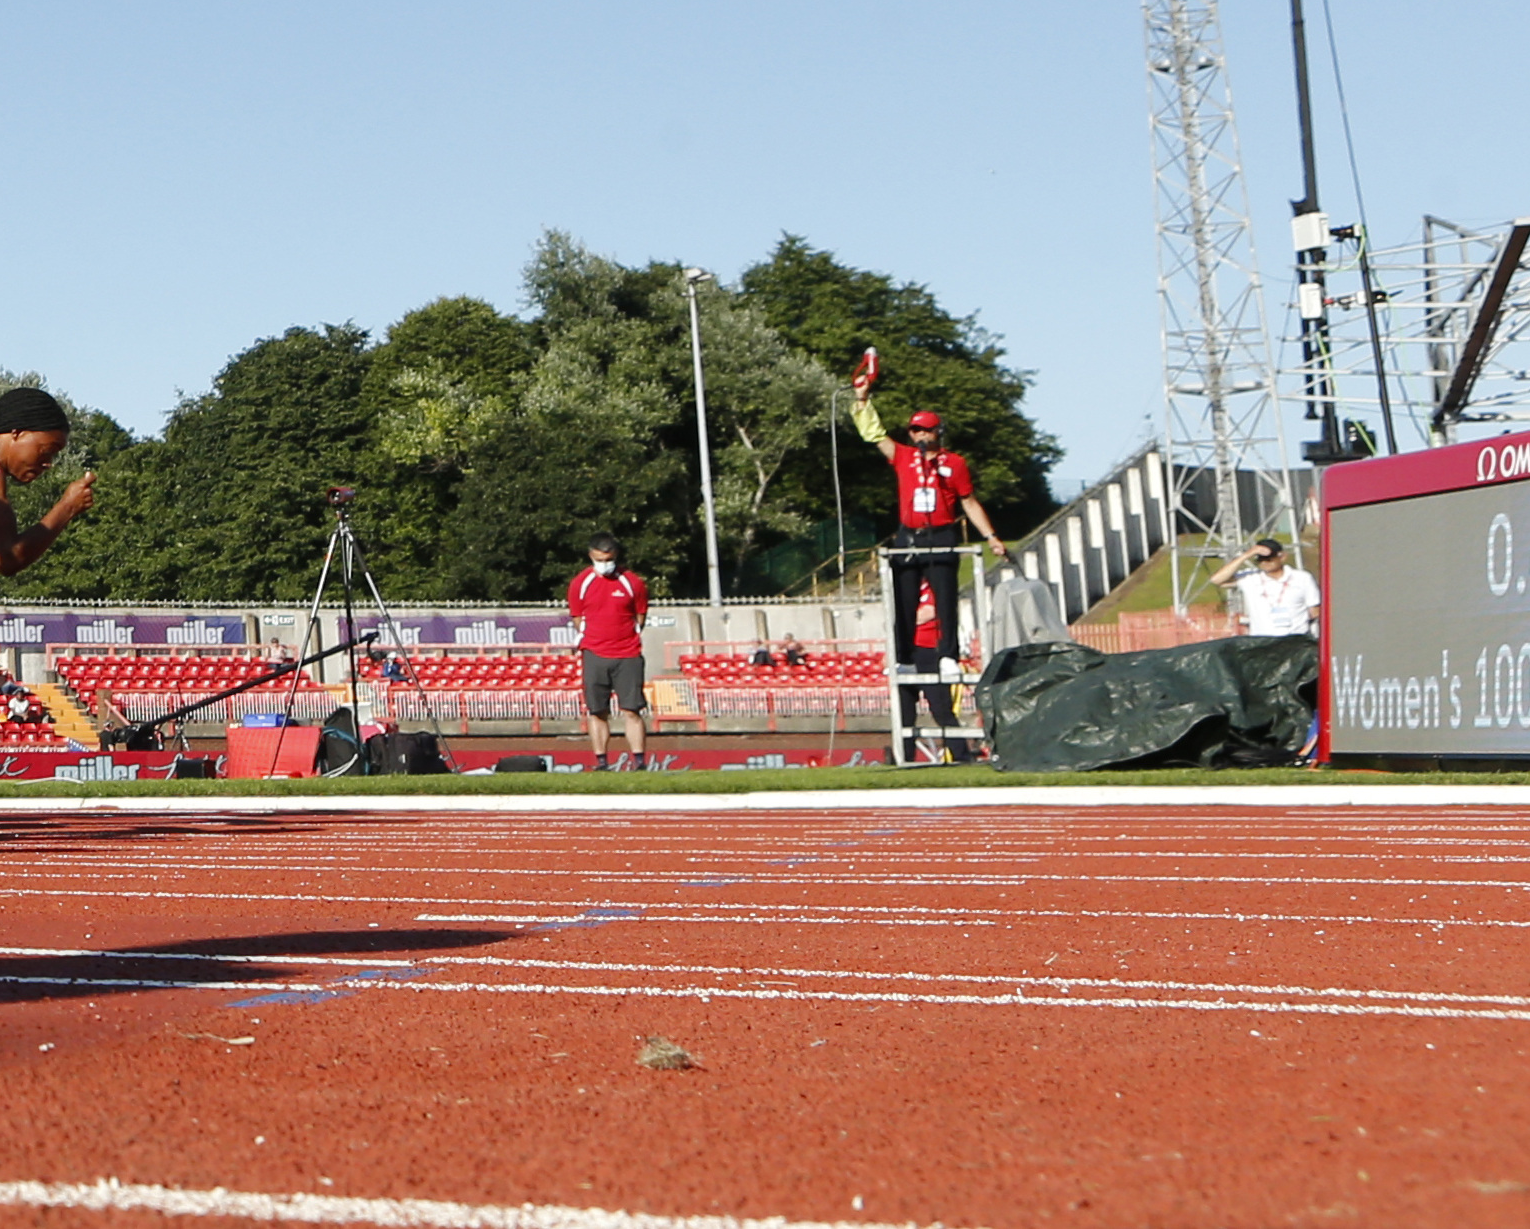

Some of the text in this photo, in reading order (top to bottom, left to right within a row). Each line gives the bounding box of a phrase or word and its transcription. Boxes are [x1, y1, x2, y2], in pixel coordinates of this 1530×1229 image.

[76, 620, 134, 643] müller
[166, 620, 225, 644] müller
[455, 621, 516, 644] müller
[1331, 649, 1462, 730] Women's
[55, 755, 139, 780] müller
[594, 751, 694, 773] Liht
